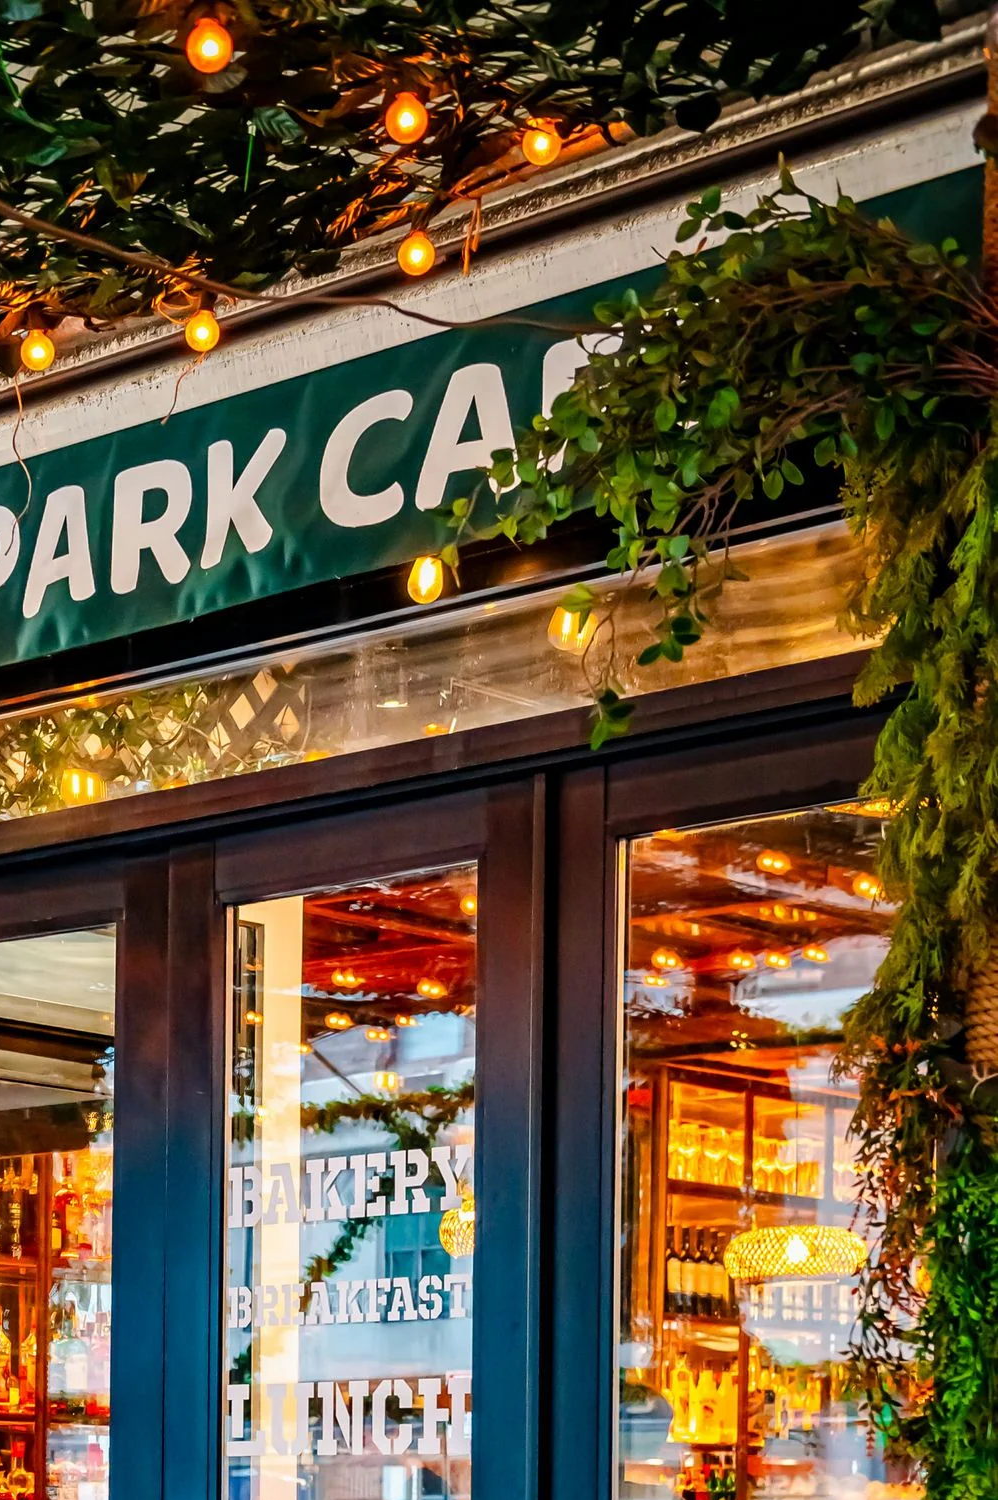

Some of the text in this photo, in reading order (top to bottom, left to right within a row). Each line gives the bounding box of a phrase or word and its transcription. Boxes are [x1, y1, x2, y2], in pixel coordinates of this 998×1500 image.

[228, 1146, 473, 1229] BAKERY
[228, 1274, 472, 1329] BREAKFAST
[227, 1377, 472, 1457] LUNCH
